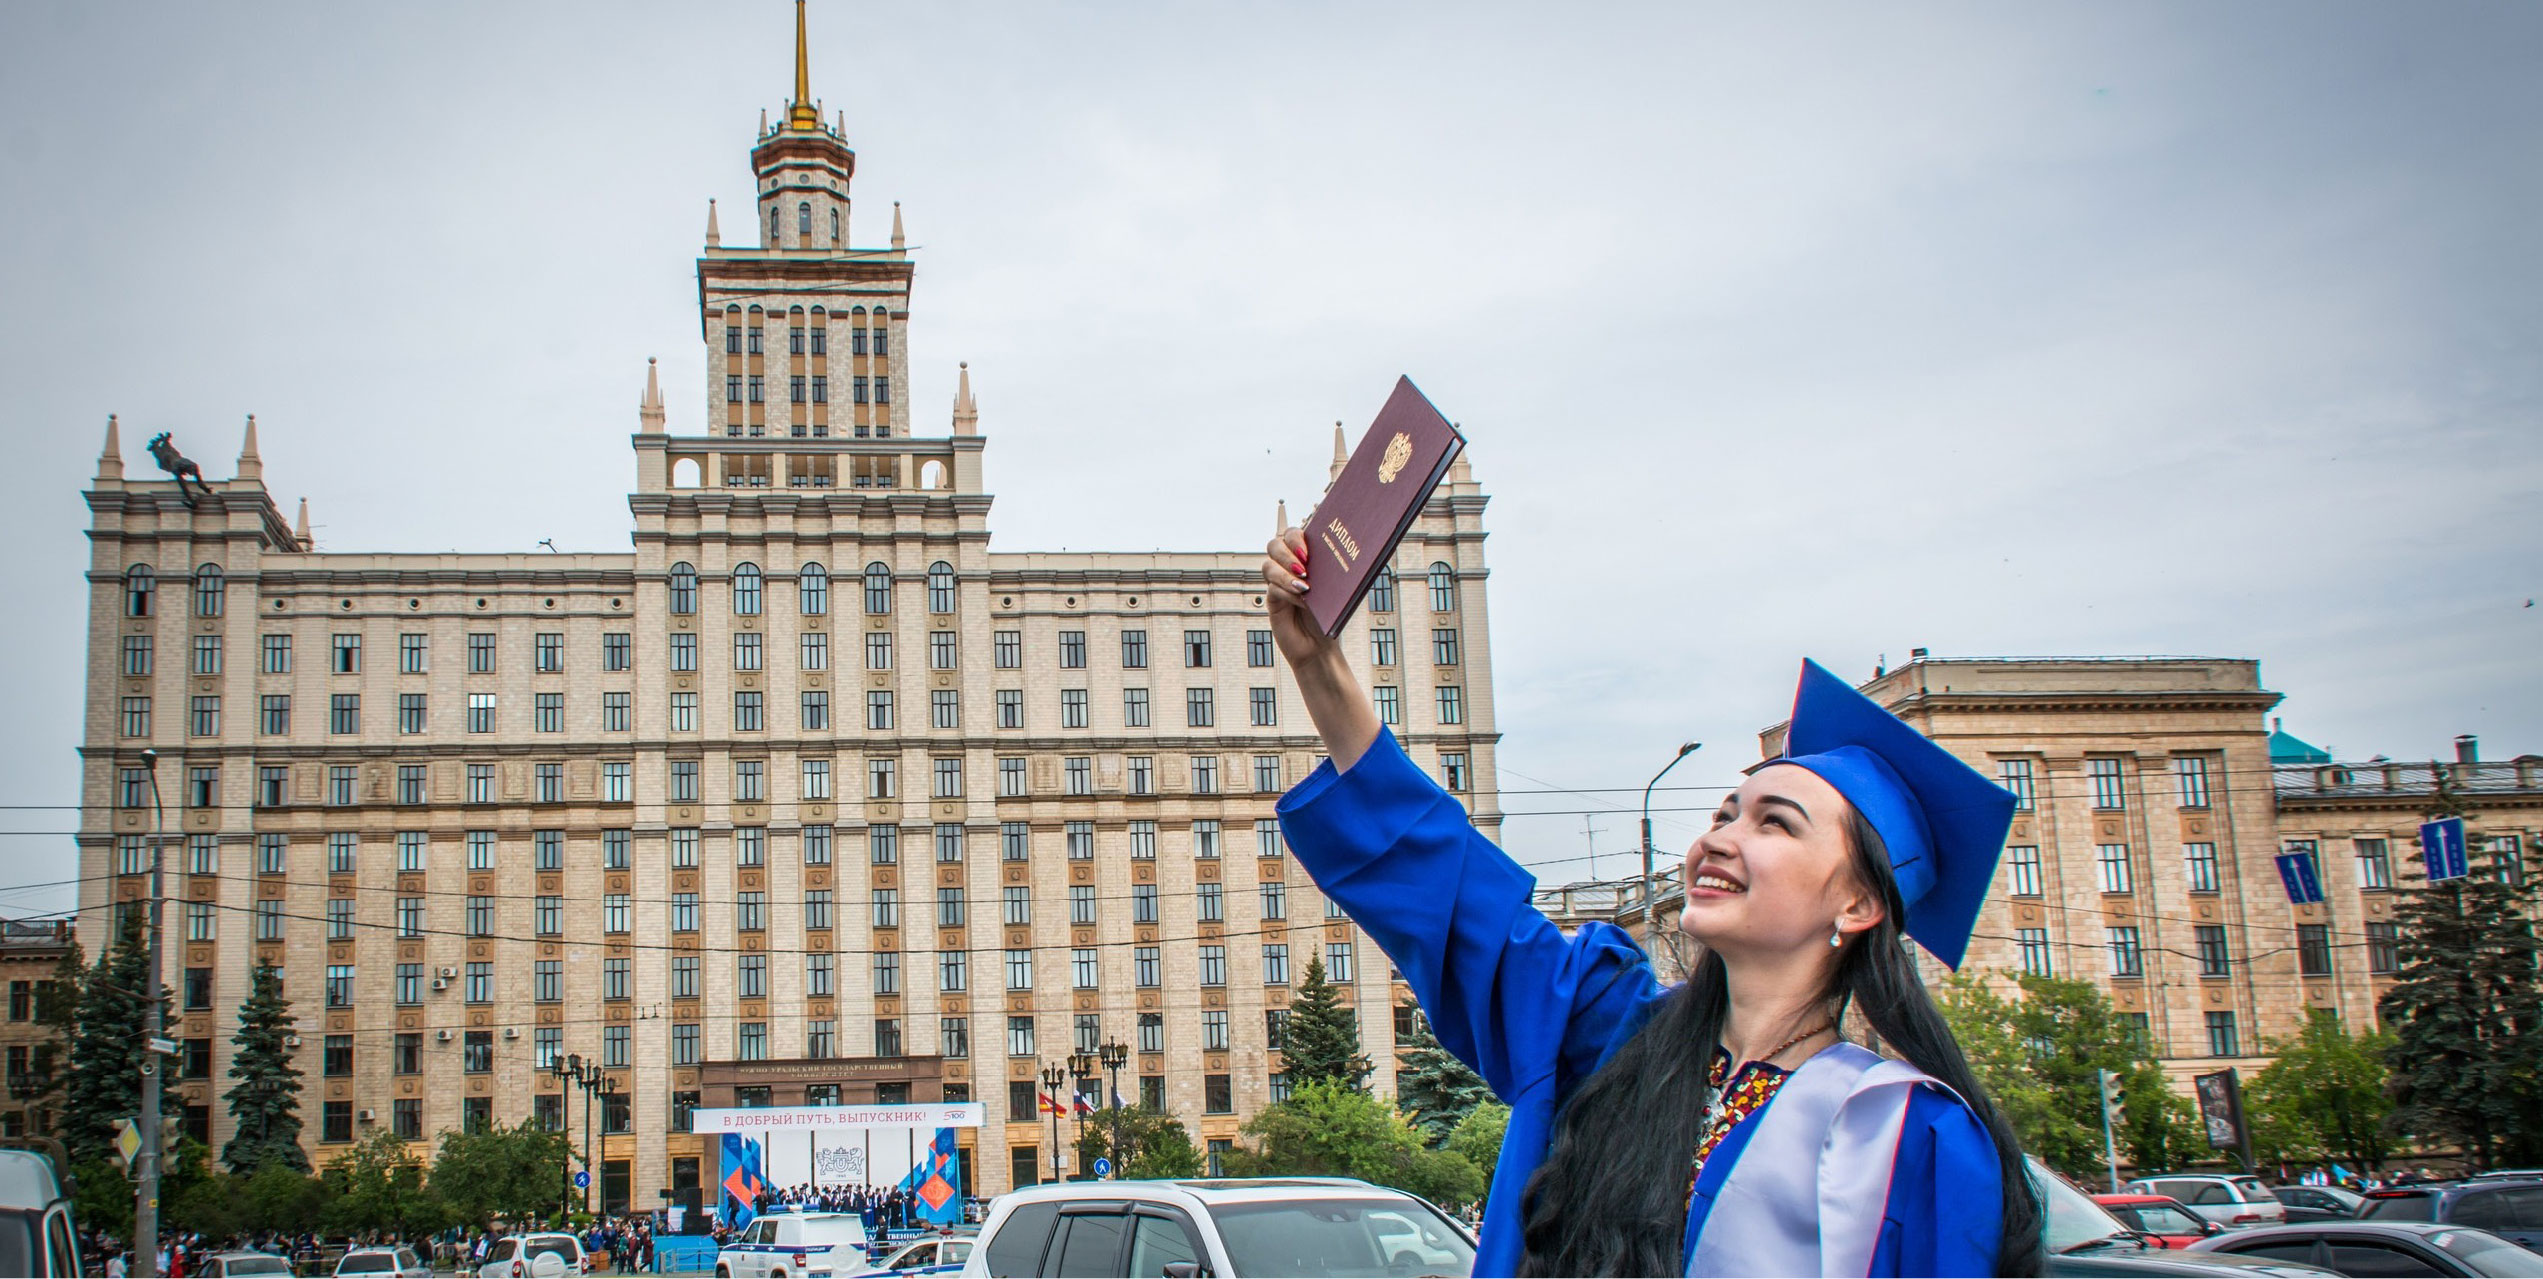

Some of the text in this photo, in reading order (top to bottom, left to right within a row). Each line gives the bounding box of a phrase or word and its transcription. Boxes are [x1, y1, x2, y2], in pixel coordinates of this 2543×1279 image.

[1328, 517, 1360, 561] ДИПЛОМ
[724, 1111, 927, 1127] В ДОБРЫЙ ПУТЬ, ВЫПУСКНИК!
